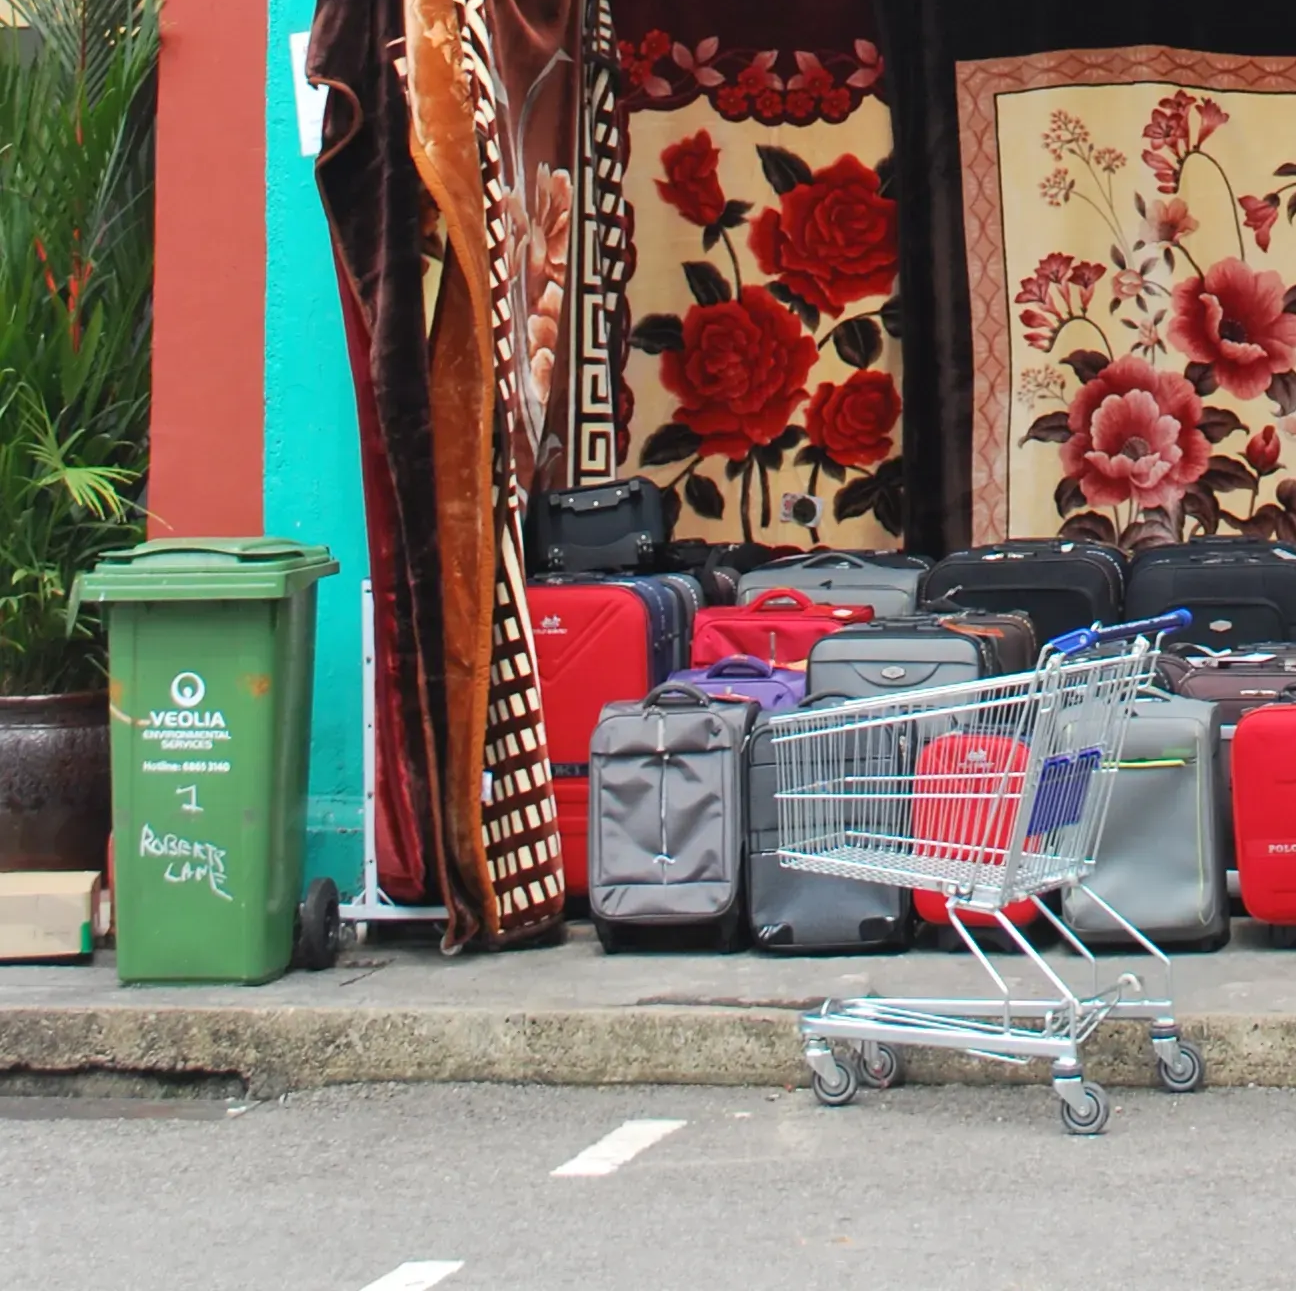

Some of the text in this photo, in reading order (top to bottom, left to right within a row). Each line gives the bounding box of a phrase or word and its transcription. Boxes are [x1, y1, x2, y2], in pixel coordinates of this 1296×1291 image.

[150, 710, 226, 728] VEOLIA
[142, 729, 231, 740] ENVIRONMENTAL
[161, 739, 213, 750] SERVICES
[142, 760, 181, 772] Hotline:
[175, 784, 204, 813] 1
[164, 861, 233, 901] LANE
